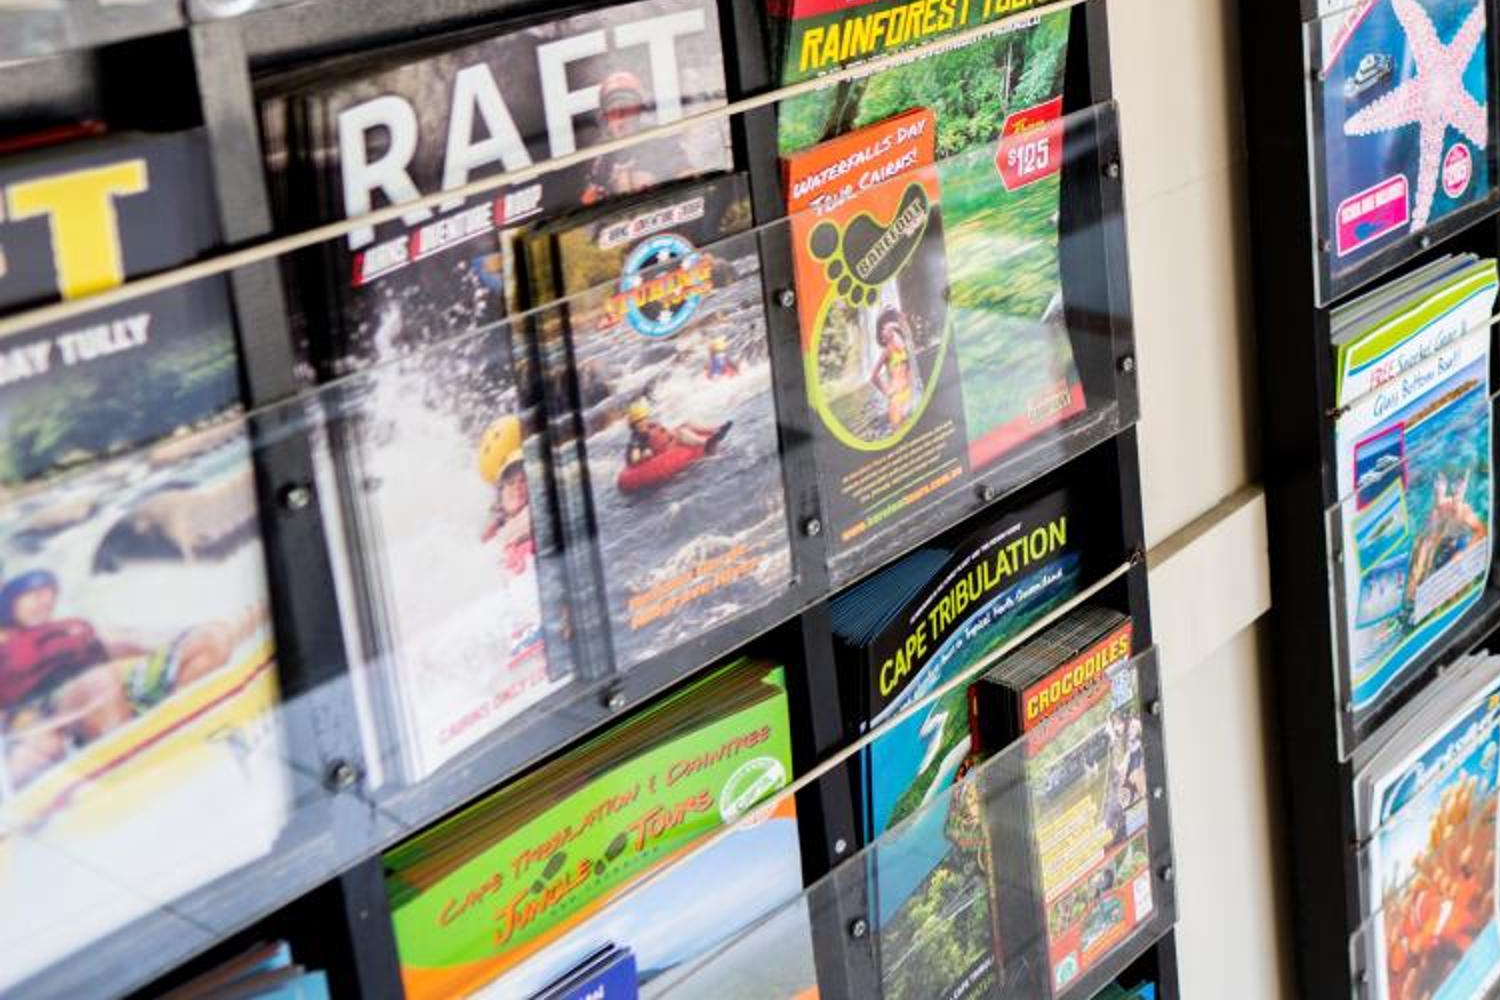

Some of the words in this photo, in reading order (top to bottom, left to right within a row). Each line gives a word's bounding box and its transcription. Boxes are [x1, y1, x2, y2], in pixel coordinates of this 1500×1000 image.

[337, 5, 708, 253] RAFT
[1007, 137, 1050, 177] $125
[0, 158, 149, 300] T
[56, 312, 151, 367] TULLY
[879, 619, 927, 697] CAPE
[928, 515, 1067, 640] TRIBULATION
[1026, 636, 1130, 722] CROCODILES
